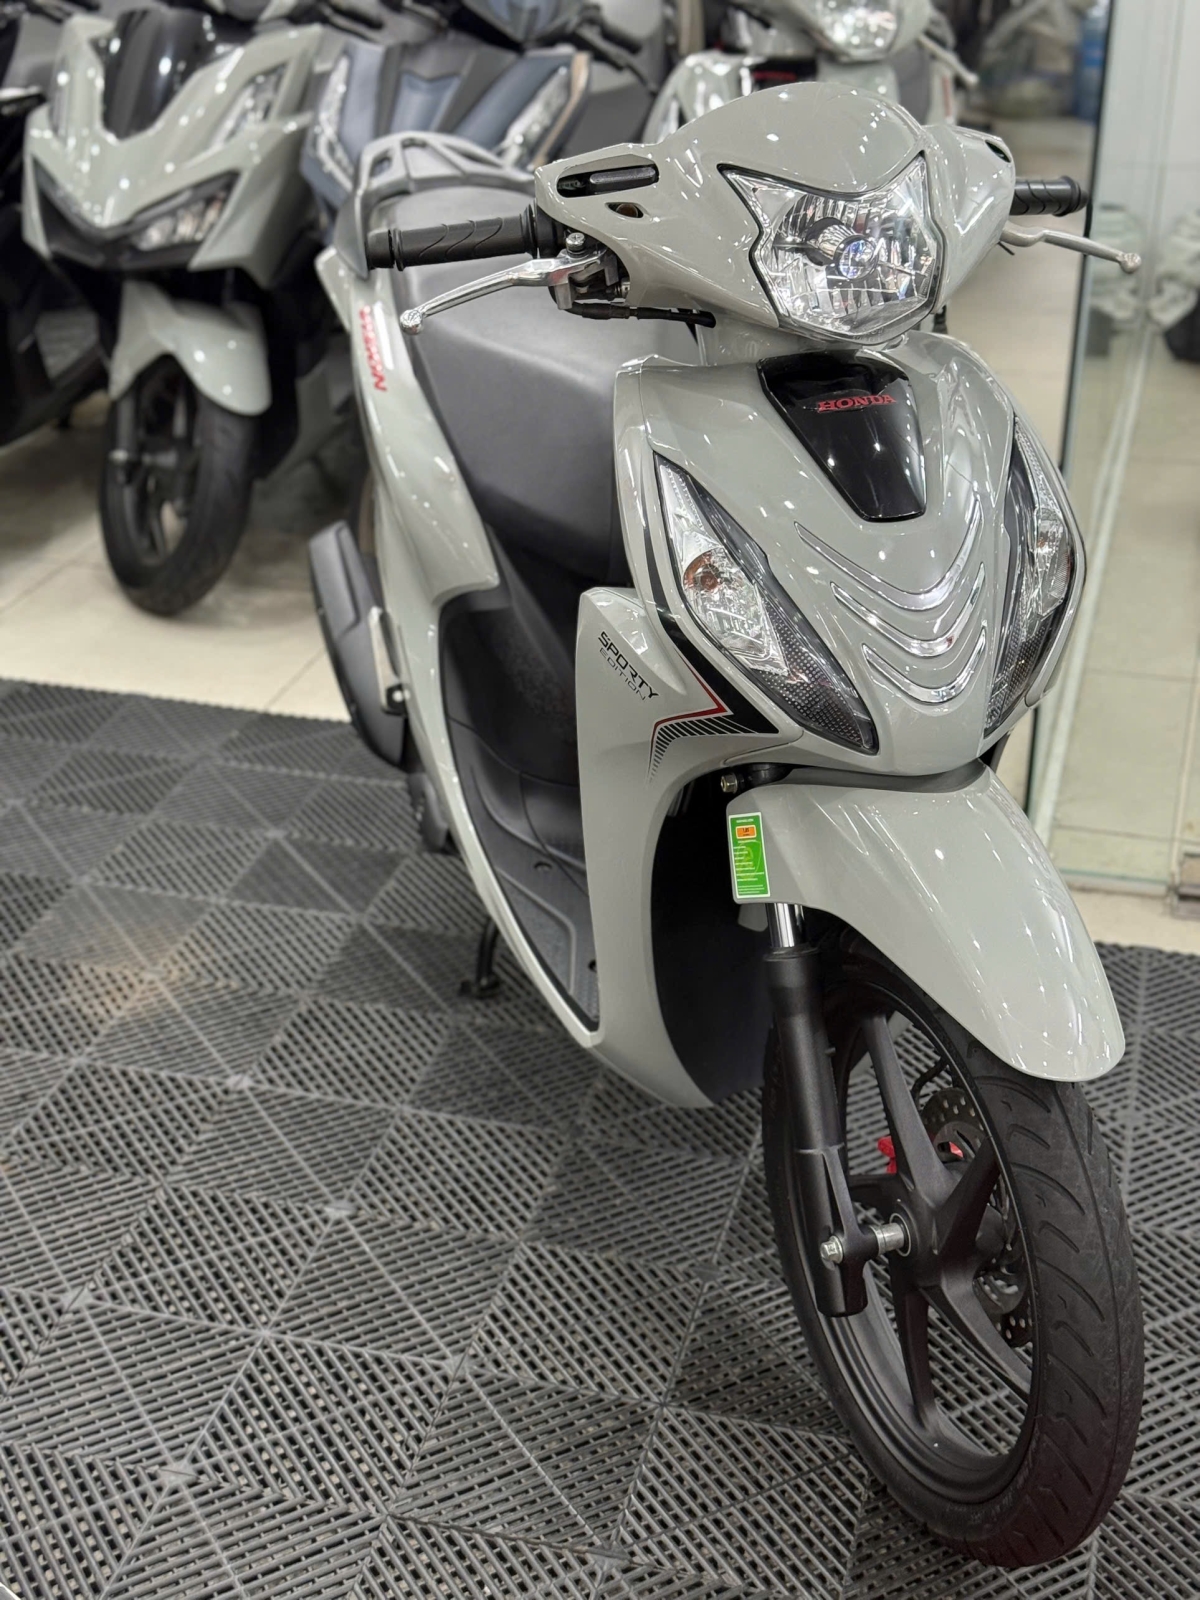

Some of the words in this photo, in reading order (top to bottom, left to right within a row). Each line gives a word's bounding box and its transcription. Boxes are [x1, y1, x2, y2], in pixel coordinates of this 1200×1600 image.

[817, 394, 897, 413] HONDA
[598, 631, 659, 699] SPORTY
[599, 647, 646, 701] EDITION
